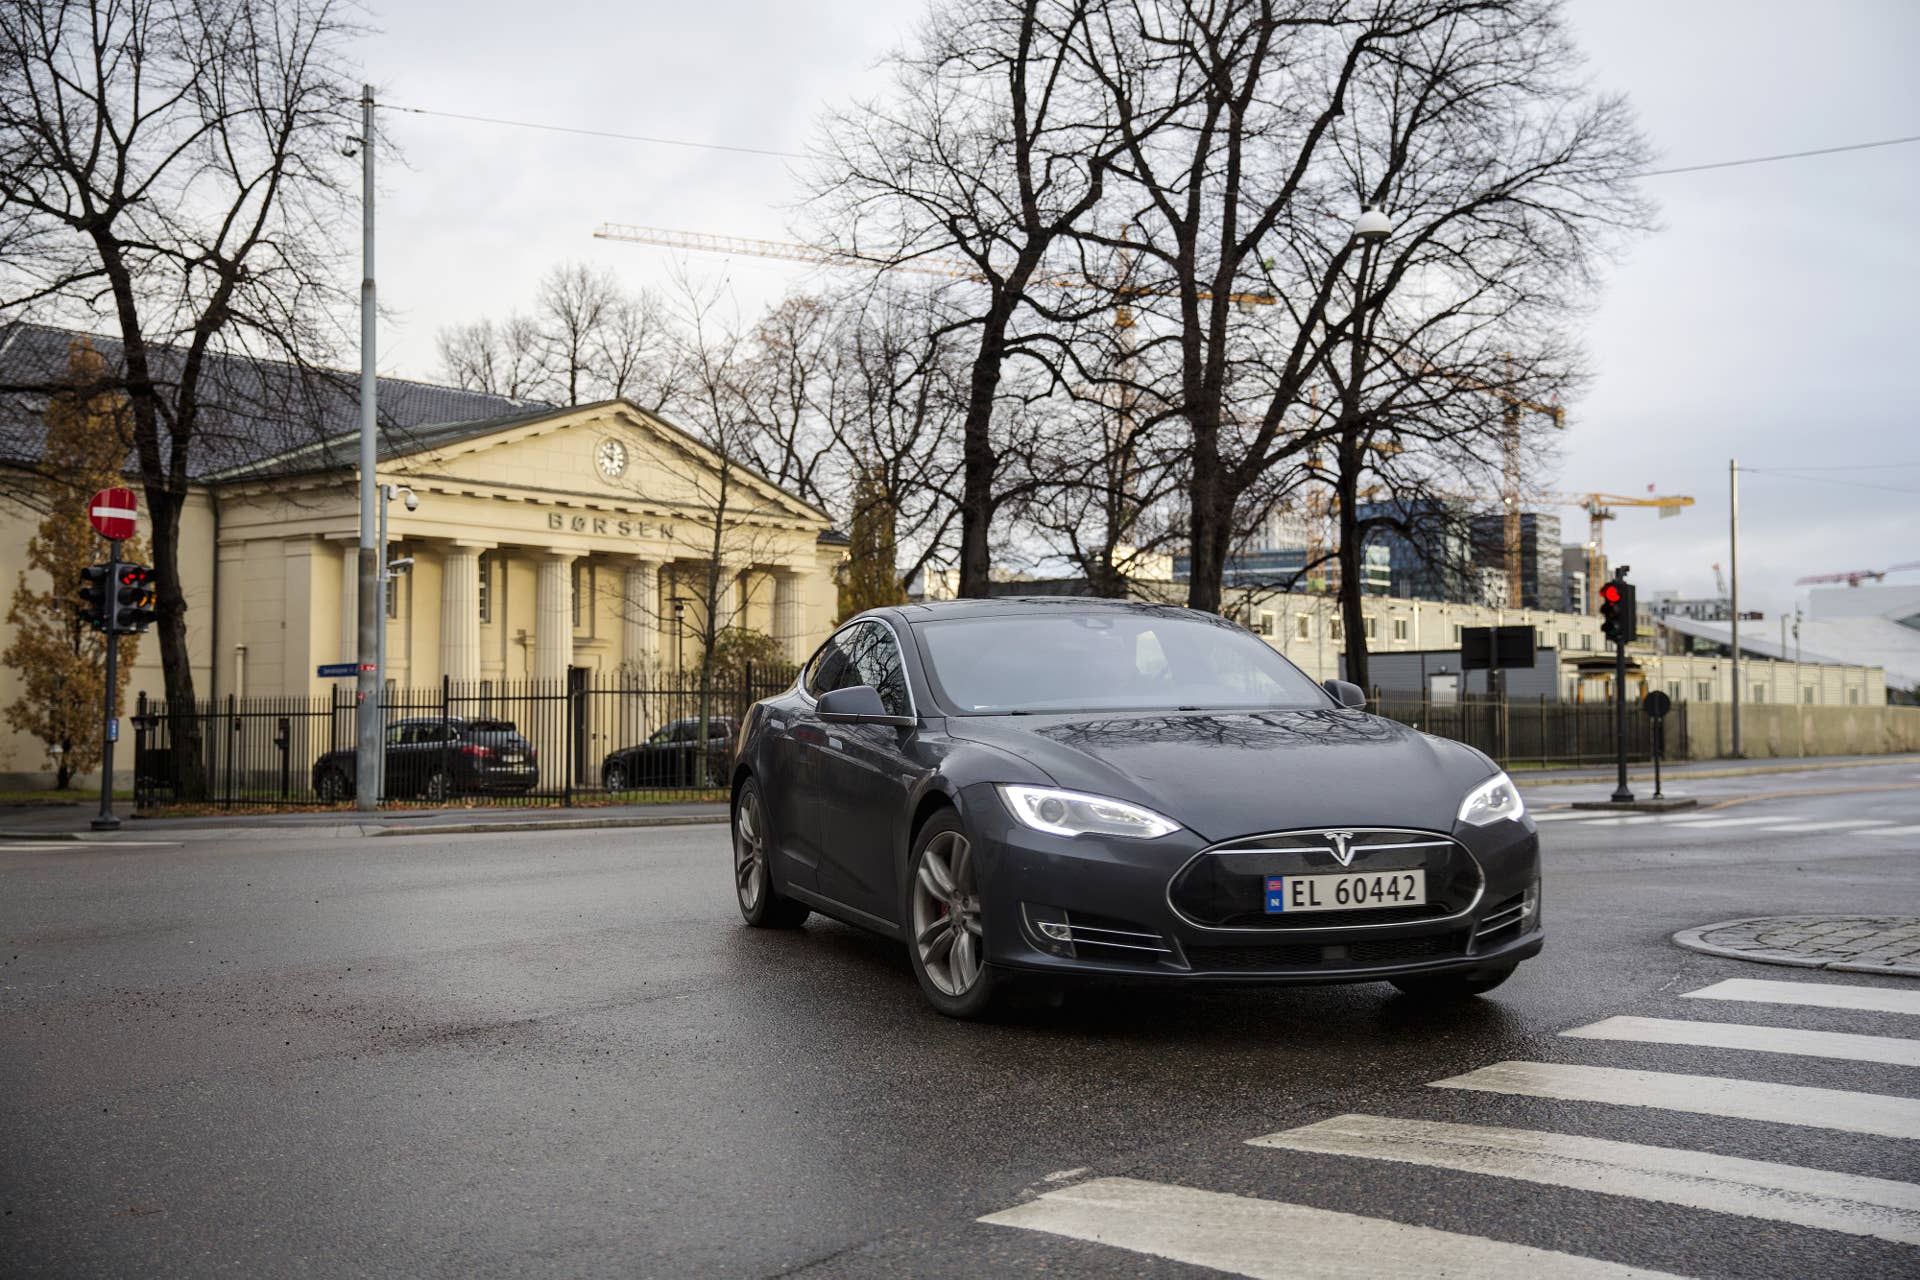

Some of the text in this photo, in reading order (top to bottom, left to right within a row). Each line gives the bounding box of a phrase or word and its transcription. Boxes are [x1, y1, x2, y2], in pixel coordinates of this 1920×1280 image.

[548, 512, 674, 539] BØRSEN
[1271, 898, 1280, 907] N
[1292, 874, 1416, 907] EL 60442
